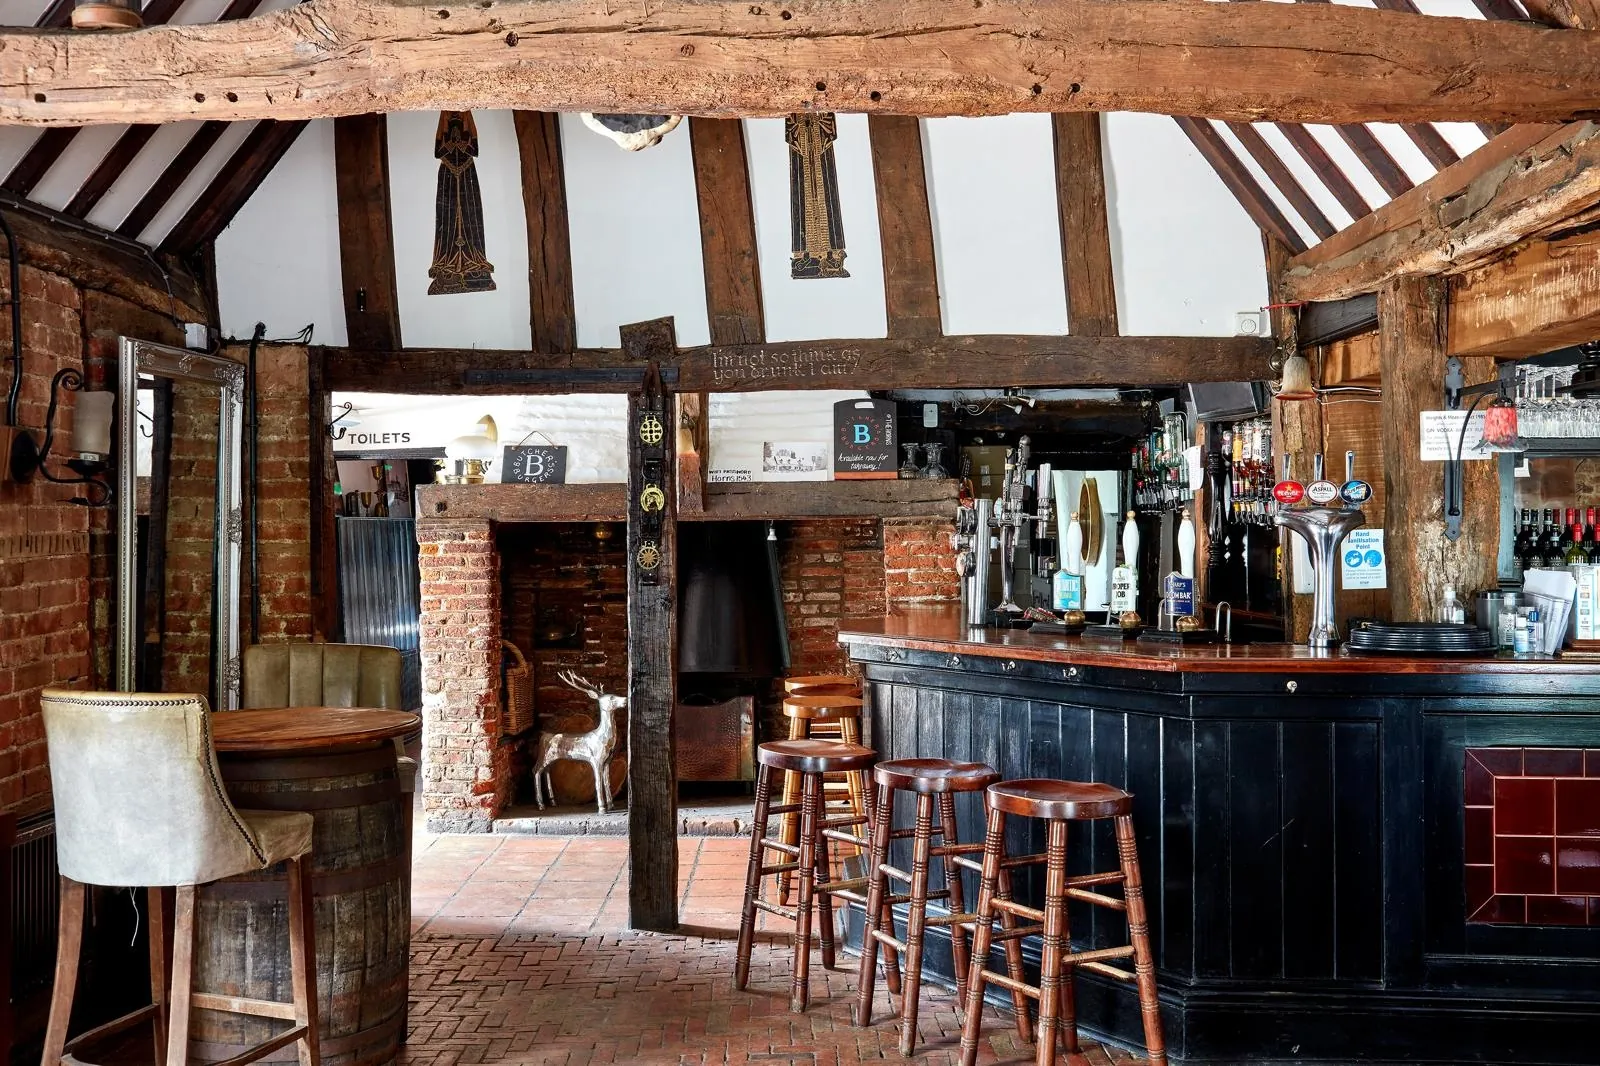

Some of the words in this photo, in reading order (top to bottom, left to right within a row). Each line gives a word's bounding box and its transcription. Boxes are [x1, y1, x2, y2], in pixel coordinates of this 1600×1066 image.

[738, 350, 765, 366] not
[771, 352, 789, 364] so
[792, 347, 837, 363] think
[713, 367, 746, 385] you
[750, 362, 806, 379] drunk
[348, 432, 411, 444] TOILETS
[853, 424, 871, 444] B
[524, 454, 544, 476] B
[877, 453, 889, 461] for
